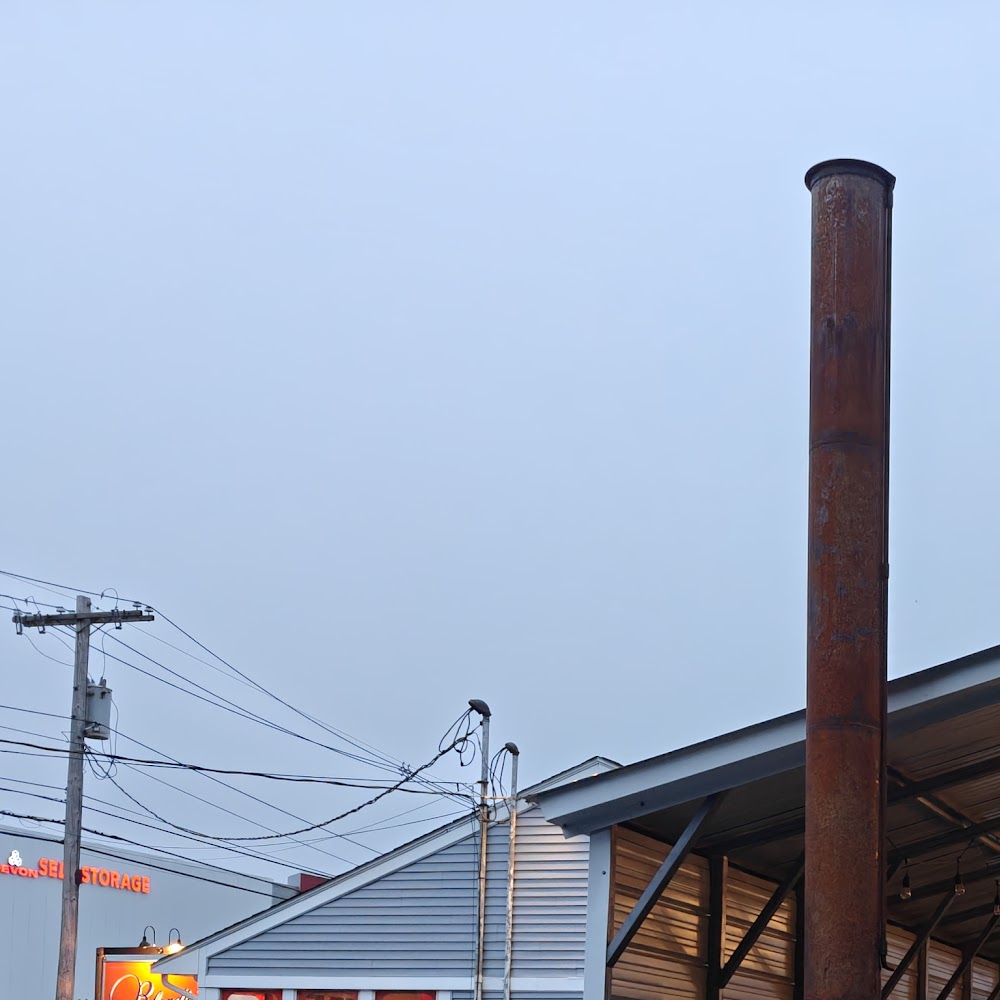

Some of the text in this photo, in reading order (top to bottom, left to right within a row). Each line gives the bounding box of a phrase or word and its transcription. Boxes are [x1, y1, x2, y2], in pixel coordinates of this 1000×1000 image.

[0, 857, 151, 894] EVON SEL STORAGE
